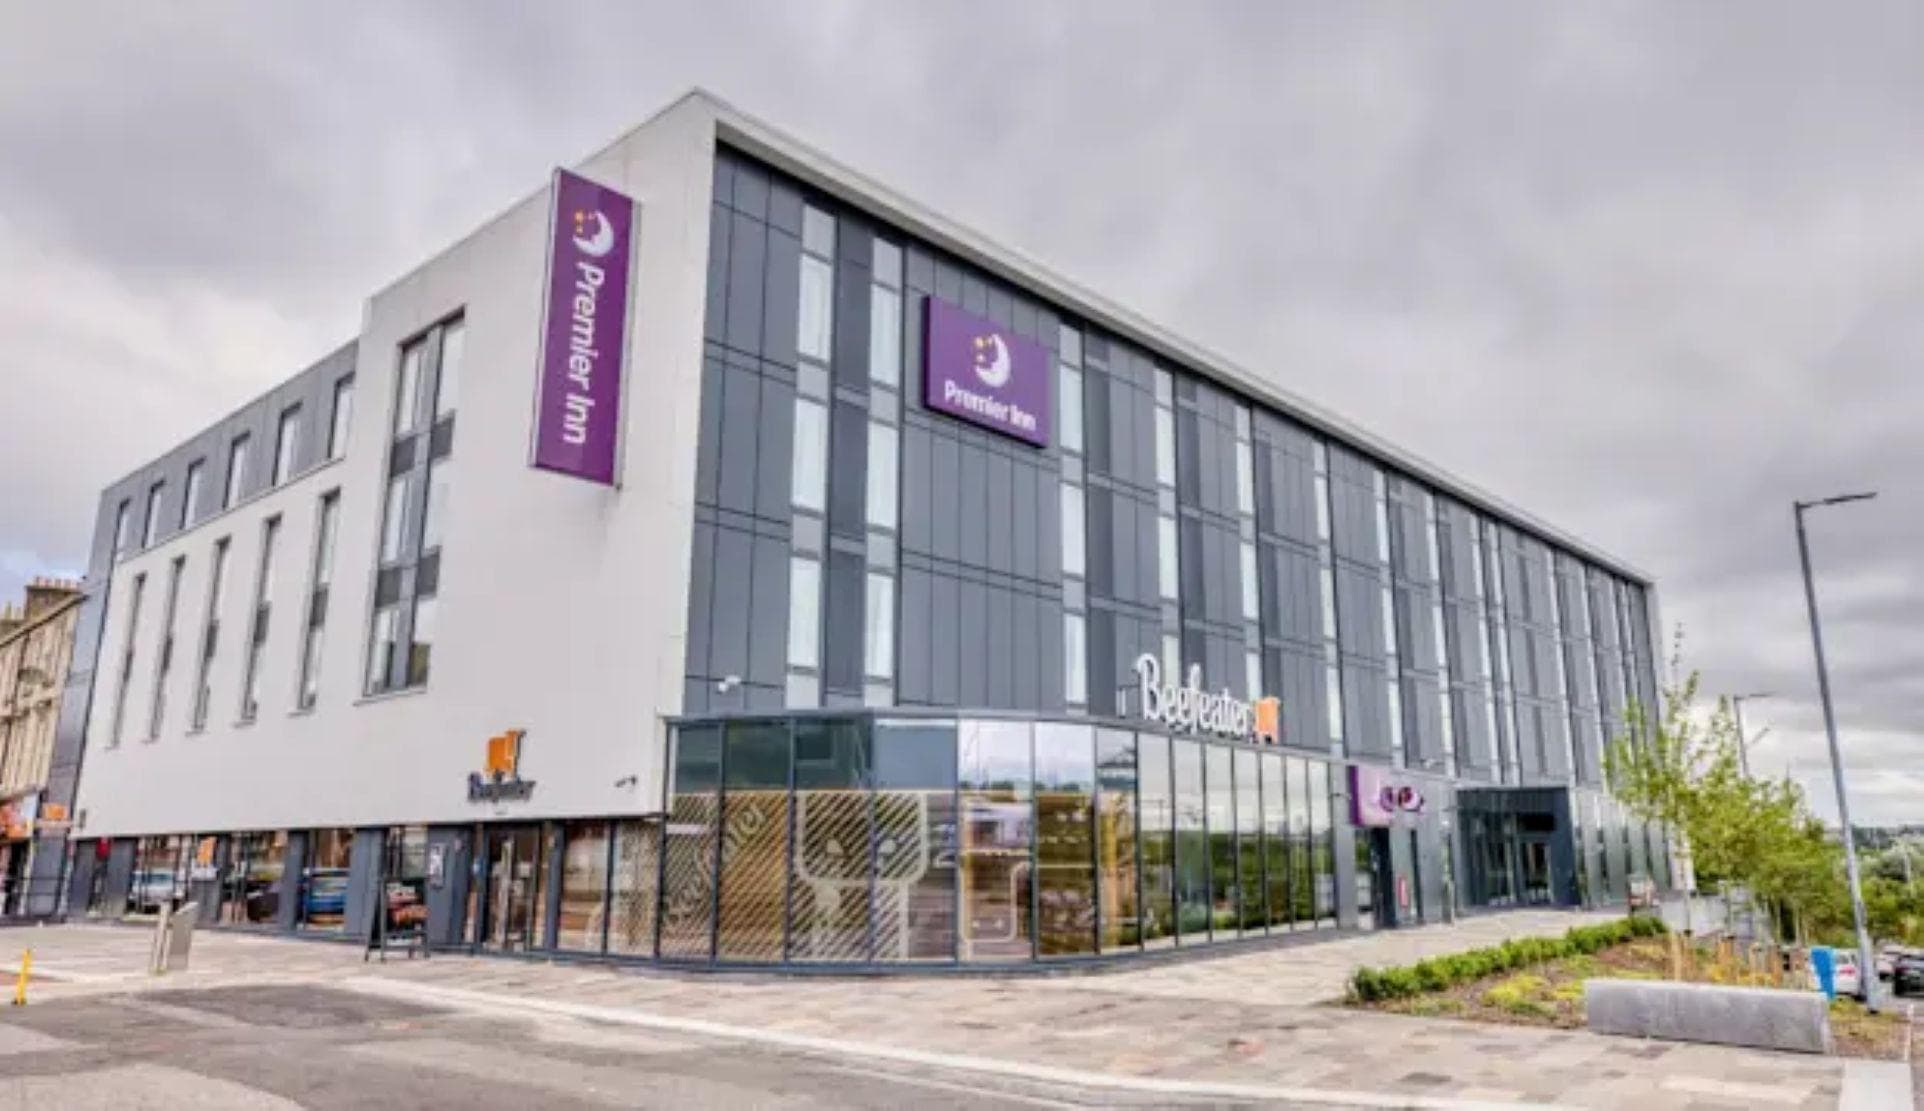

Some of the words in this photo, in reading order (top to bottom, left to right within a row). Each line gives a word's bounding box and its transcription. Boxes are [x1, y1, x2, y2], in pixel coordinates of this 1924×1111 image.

[567, 261, 605, 391] Premier
[562, 393, 596, 445] Inn
[944, 379, 1009, 422] Premier
[1009, 404, 1037, 432] Inn
[1137, 653, 1250, 738] Beefeater
